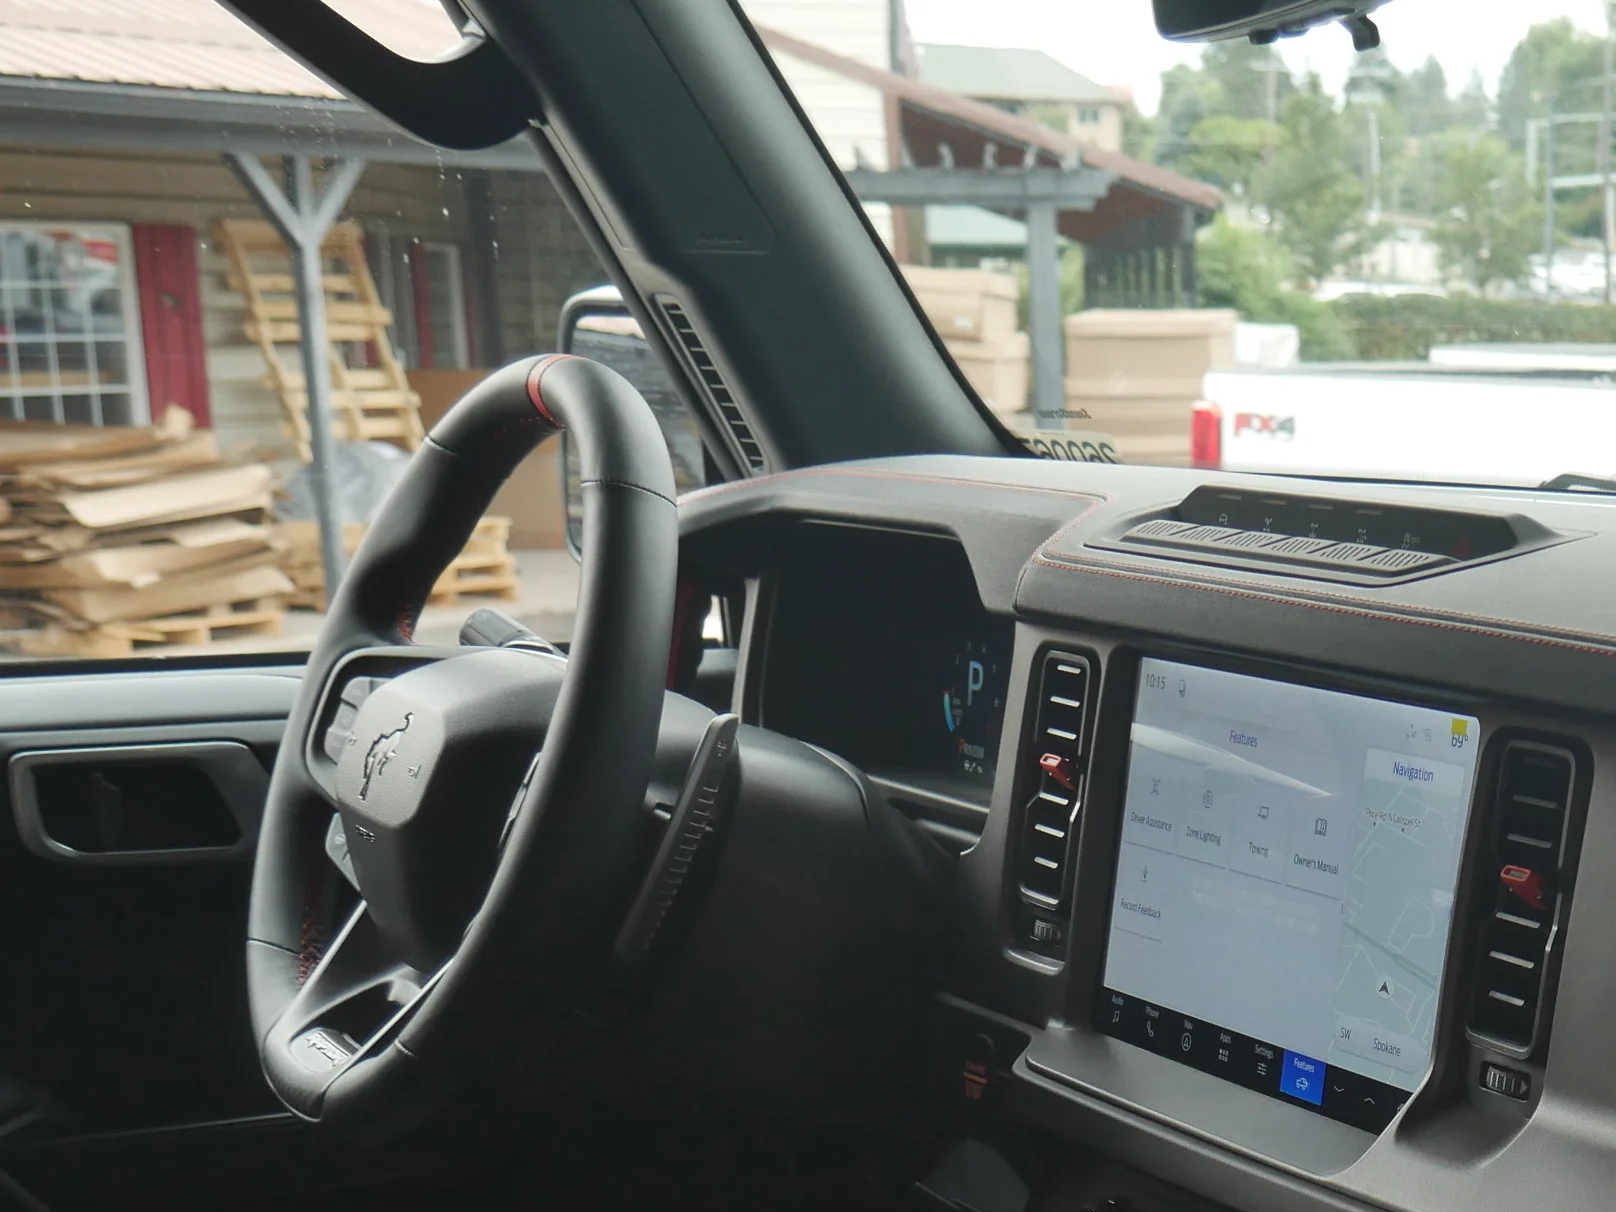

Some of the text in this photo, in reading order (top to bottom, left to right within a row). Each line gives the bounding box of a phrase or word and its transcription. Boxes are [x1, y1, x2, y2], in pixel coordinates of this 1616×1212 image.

[1234, 412, 1295, 439] FX4
[968, 660, 984, 707] P
[1146, 671, 1166, 691] 10:15
[1229, 729, 1258, 748] Features
[1392, 761, 1433, 784] Navigation
[1186, 824, 1220, 846] Zone Lighting
[1294, 852, 1338, 875] Owner's Manual
[1340, 1026, 1351, 1040] SW
[1254, 1042, 1273, 1059] Settings
[1373, 1036, 1400, 1057] Spokane
[1293, 1056, 1314, 1074] Features
